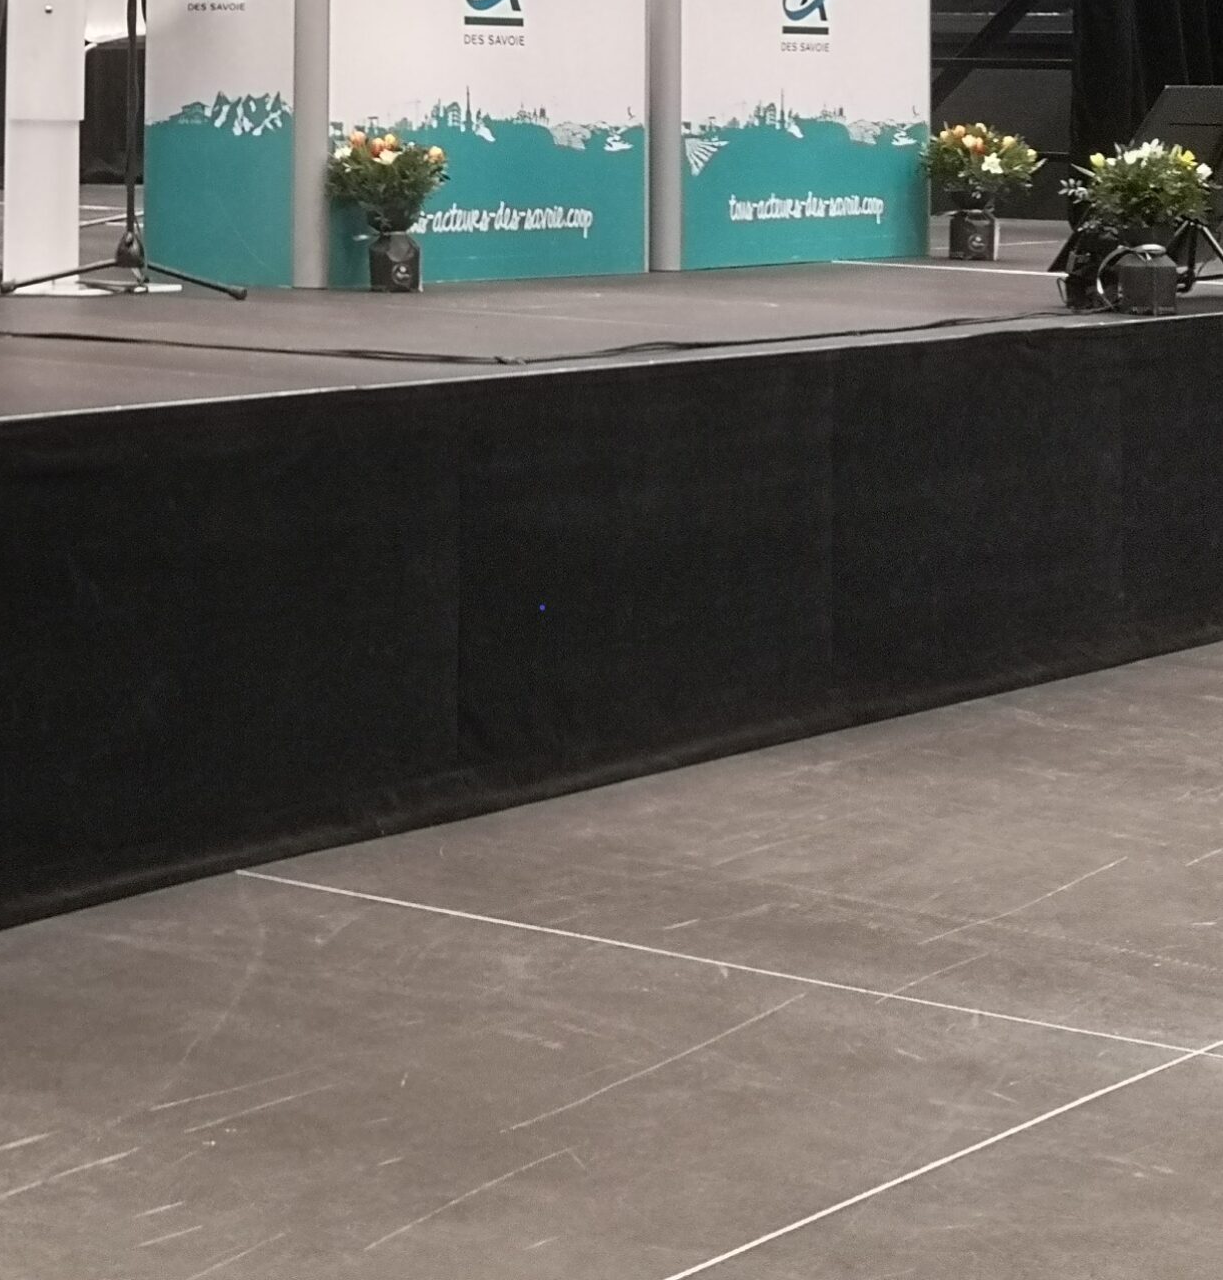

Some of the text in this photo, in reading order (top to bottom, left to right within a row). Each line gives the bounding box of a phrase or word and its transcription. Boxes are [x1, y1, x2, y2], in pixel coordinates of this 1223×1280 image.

[187, 3, 245, 11] DES SAVOIE
[464, 34, 525, 46] DES SAVOIE
[781, 42, 829, 52] DES SAVOIE
